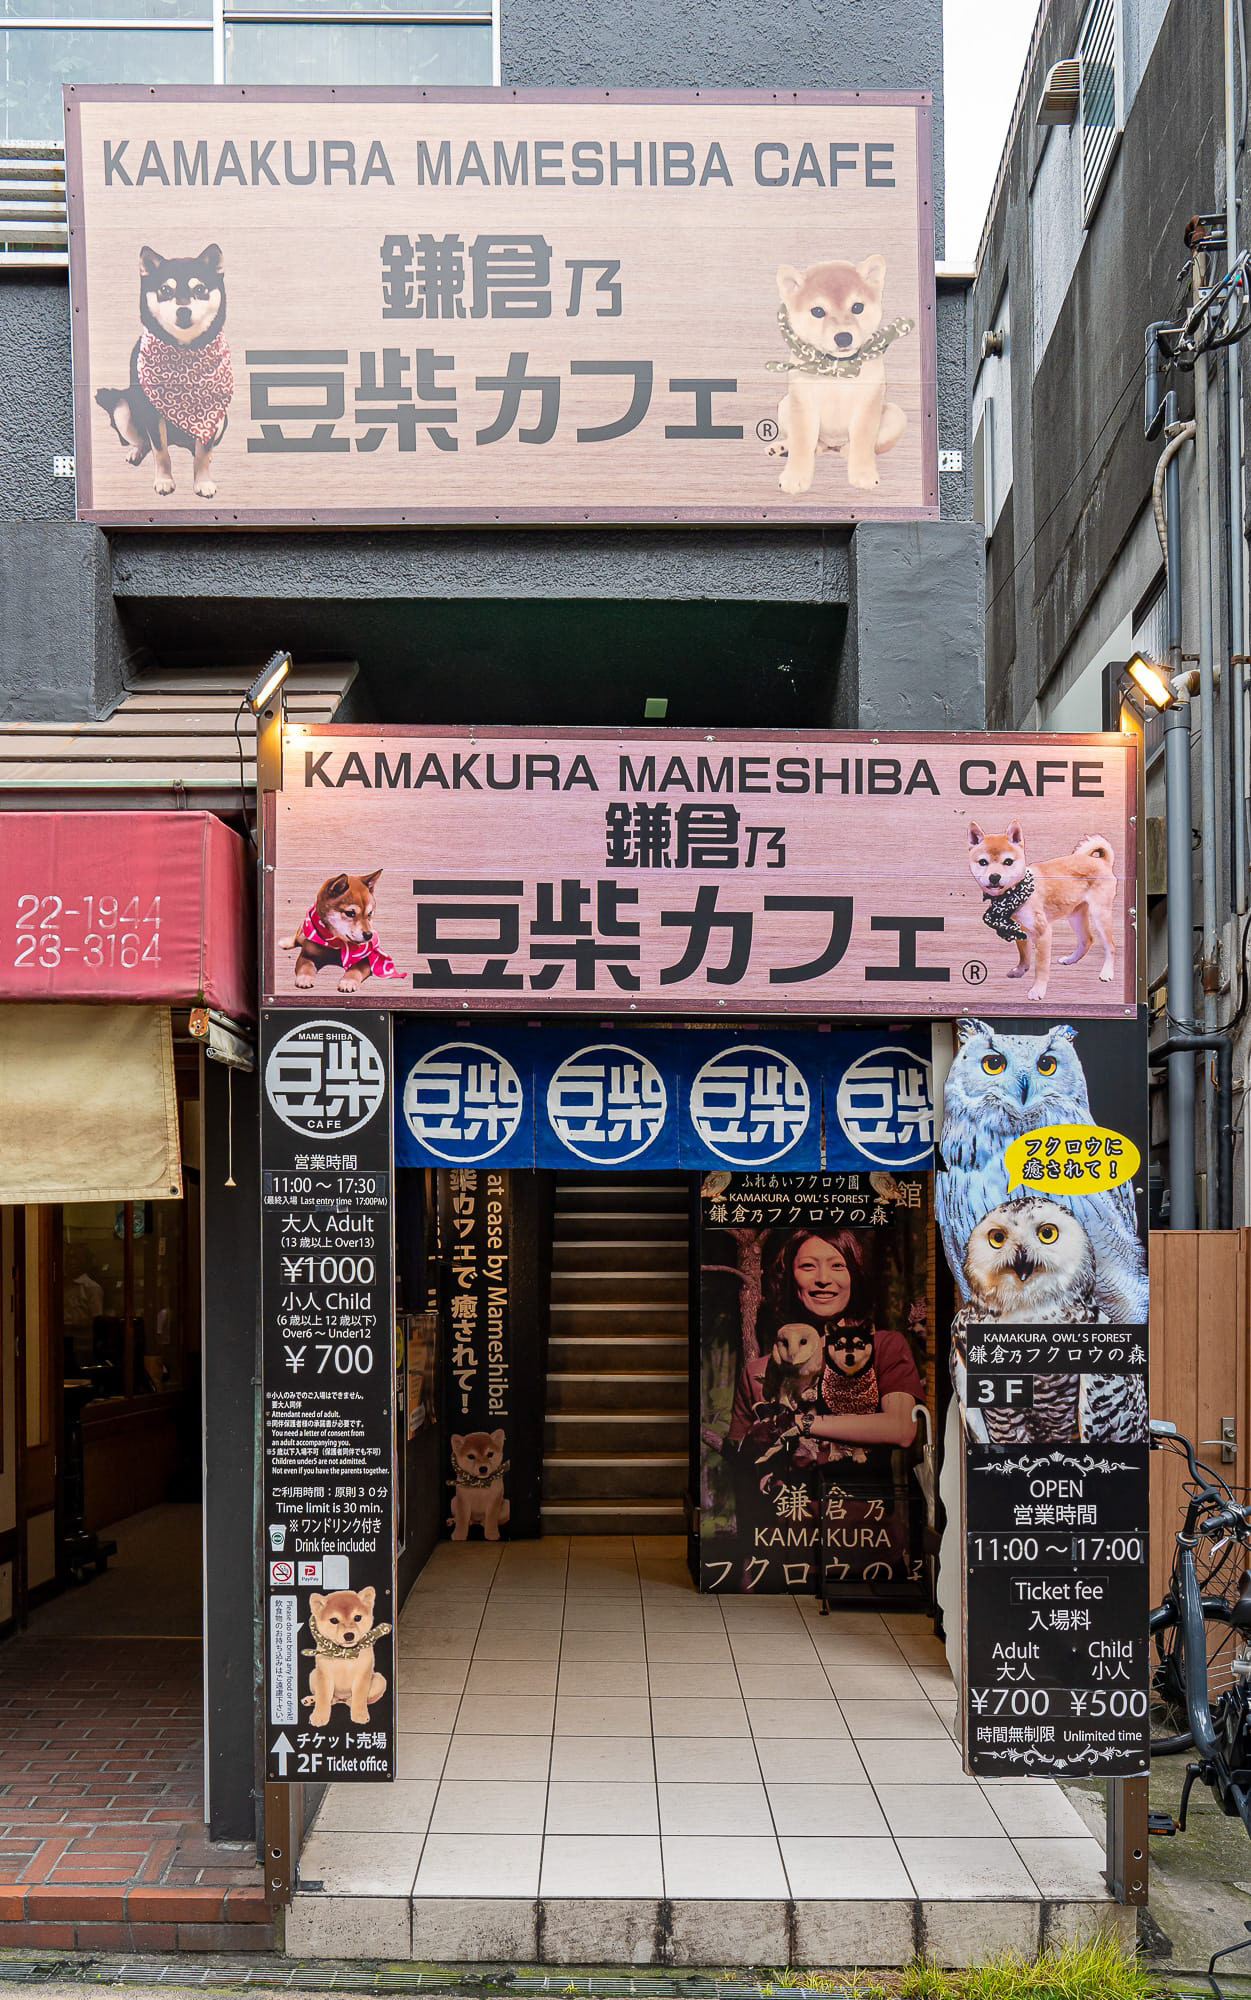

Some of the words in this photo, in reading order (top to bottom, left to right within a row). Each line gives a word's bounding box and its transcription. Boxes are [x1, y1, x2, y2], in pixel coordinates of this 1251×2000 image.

[103, 139, 395, 187] KAMAKURA
[417, 141, 734, 188] MAMESHIBA
[755, 142, 896, 189] CAFE
[380, 233, 622, 319] 鎌倉乃
[246, 348, 743, 453] 豆柴カフェ
[304, 751, 598, 791] KAMAKURA
[618, 756, 941, 795] MAMESHIBA
[960, 760, 1105, 798] CAFE
[605, 802, 786, 869] 鎌倉乃
[15, 894, 163, 930] 22-1944
[412, 879, 951, 991] 豆柴カフェ
[13, 933, 162, 968] 23-3164
[299, 1033, 323, 1041] MAME
[326, 1033, 353, 1041] SHIBA
[1025, 1137, 1123, 1156] フクロウに
[294, 1154, 358, 1171] 営業時間
[273, 1177, 312, 1194] 11:00
[337, 1177, 376, 1194] 17:30
[487, 1174, 505, 1196] at
[741, 1174, 860, 1190] ふれあいフクロウ園
[301, 1197, 314, 1206] Last
[315, 1198, 335, 1207] entry
[336, 1198, 352, 1206] time
[729, 1193, 790, 1203] KAMAKURA
[831, 1194, 870, 1204] FOREST
[281, 1213, 321, 1233] 大人
[326, 1214, 375, 1233] Adult
[708, 1203, 889, 1226] 鎌倉乃フクロウの森
[487, 1201, 503, 1249] ease
[282, 1256, 375, 1284] ¥1000
[482, 1255, 508, 1281] by
[281, 1291, 321, 1311] 小人
[326, 1292, 371, 1310] Child
[282, 1328, 313, 1339] Over6
[328, 1328, 371, 1339] Under12
[983, 1333, 1047, 1343] KAMAKURA
[1091, 1333, 1133, 1343] FOREST
[487, 1286, 509, 1417] Mameshiba!
[968, 1344, 1147, 1365] 鎌倉乃フクロウの森
[1030, 1479, 1083, 1498] OPEN
[275, 1502, 303, 1513] Time
[306, 1502, 330, 1513] limit
[333, 1502, 341, 1513] is
[343, 1502, 357, 1513] 30
[359, 1502, 384, 1513] min.
[1013, 1504, 1097, 1526] 営業時間
[295, 1538, 319, 1553] Drink
[321, 1538, 335, 1553] fee
[337, 1538, 376, 1553] included
[974, 1538, 1039, 1561] 11:00
[1077, 1537, 1141, 1561] 17:00
[1015, 1581, 1070, 1600] Ticket
[1075, 1580, 1103, 1600] fee
[1028, 1609, 1091, 1631] 入場料
[992, 1641, 1040, 1659] Adult
[1089, 1641, 1133, 1658] Child
[997, 1662, 1036, 1681] 大人
[1091, 1661, 1130, 1681] 小人
[971, 1688, 1049, 1716] ¥700
[1070, 1689, 1147, 1717] ¥500
[297, 1732, 387, 1750] チケット売場
[976, 1726, 1055, 1743] 時間無制限
[1063, 1729, 1115, 1742] Unlimited
[1118, 1730, 1142, 1742] time
[297, 1753, 323, 1773] 2F
[327, 1756, 361, 1772] Ticket
[363, 1756, 388, 1772] office
